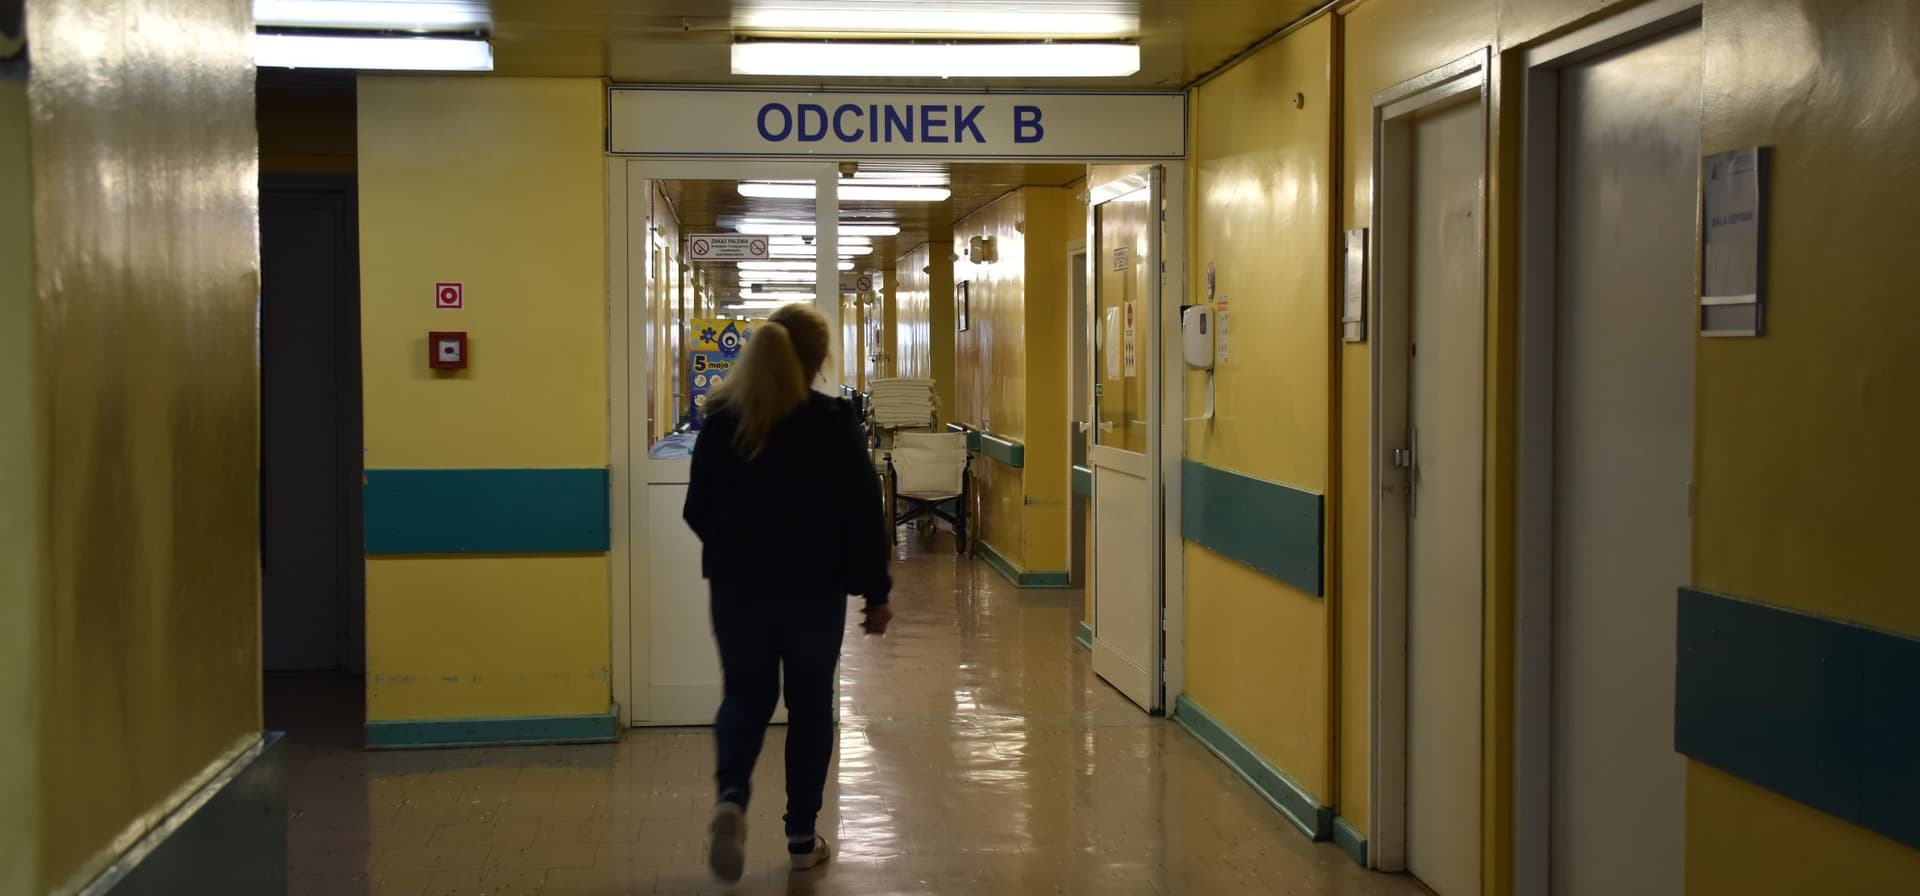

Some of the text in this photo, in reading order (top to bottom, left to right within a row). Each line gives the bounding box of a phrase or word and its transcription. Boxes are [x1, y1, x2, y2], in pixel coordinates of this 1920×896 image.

[757, 103, 1044, 143] ODCINEK B
[694, 355, 729, 371] 5 maja
